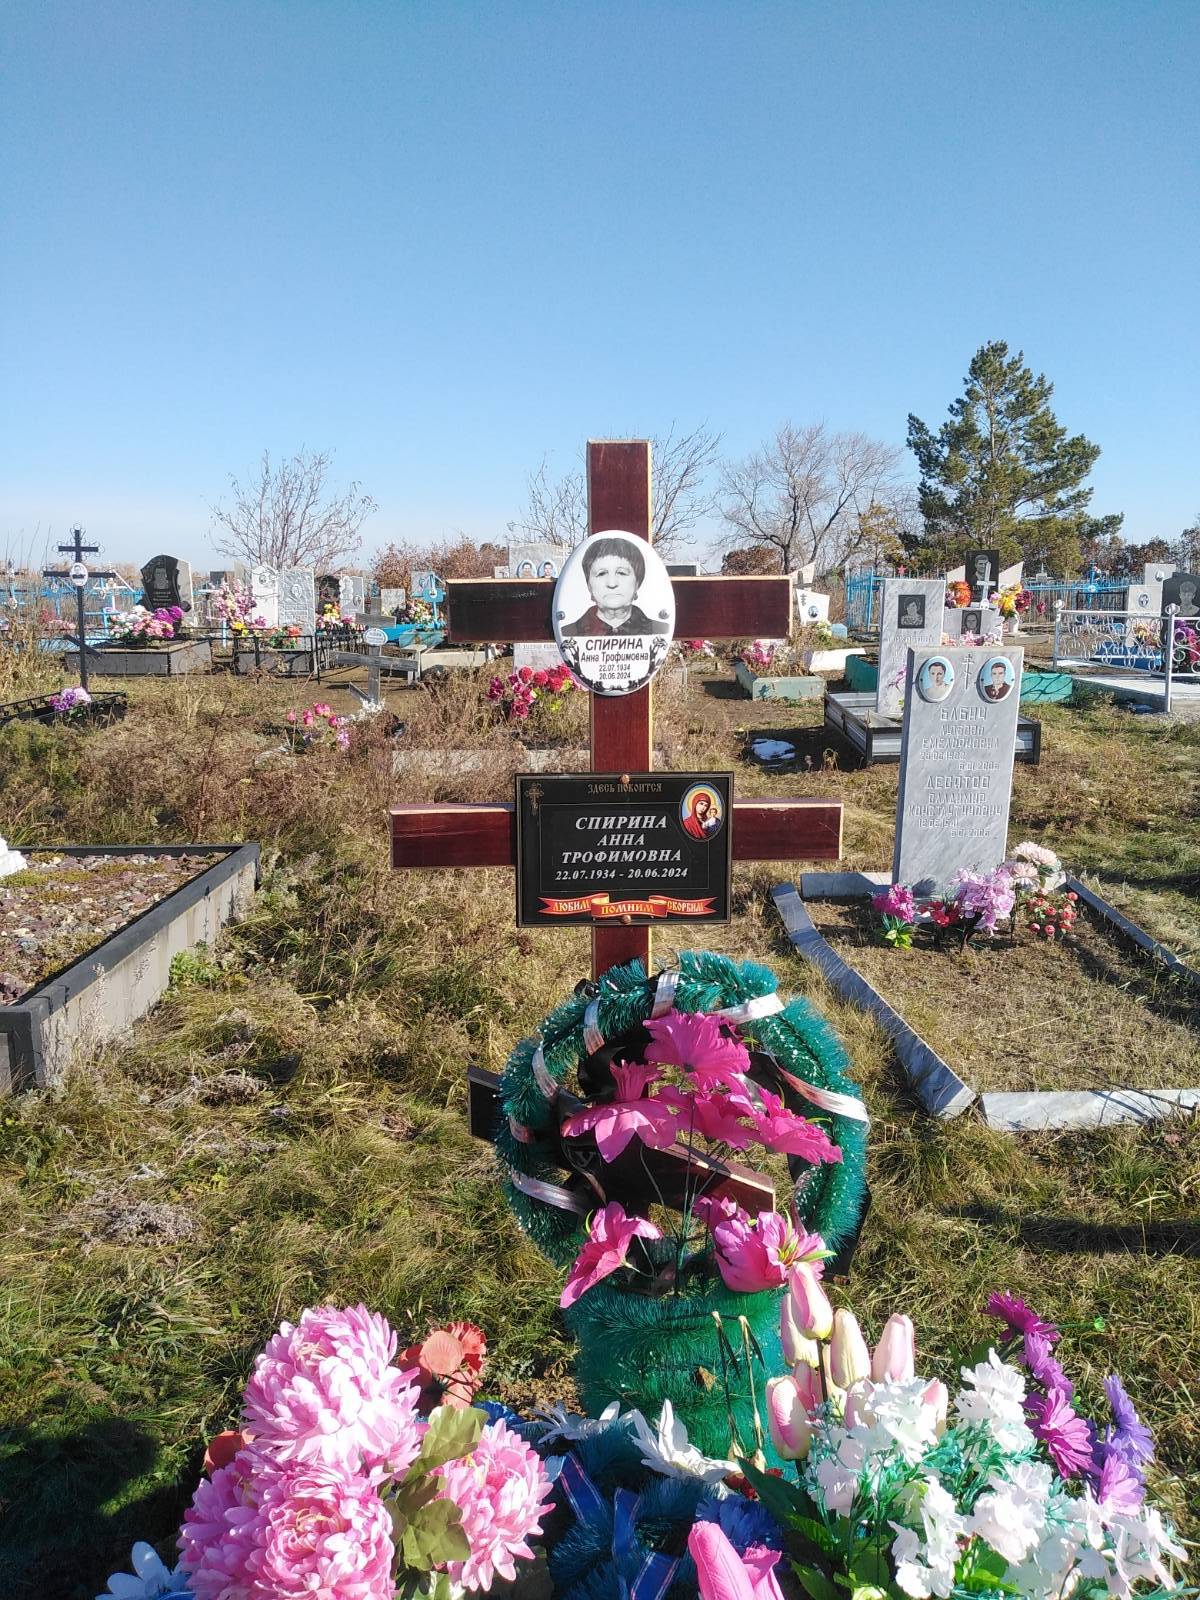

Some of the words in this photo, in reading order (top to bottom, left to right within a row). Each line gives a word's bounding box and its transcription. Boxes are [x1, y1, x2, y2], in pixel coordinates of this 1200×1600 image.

[586, 638, 643, 651] СПИРИНА
[581, 652, 599, 662] Анна
[602, 651, 649, 663] Трофимовна
[599, 664, 631, 672] 22.07.1934
[599, 672, 631, 680] 20.06.2024
[940, 707, 988, 721] БАБИЧ
[587, 784, 615, 794] ЗДЕСЬ
[617, 783, 663, 793] ПОКОИТСЯ
[928, 792, 986, 804] ВЛАДИМИР
[907, 804, 1003, 817] КОНСТАНТИНОВИЧ
[575, 816, 668, 830] СПИРИНА
[597, 834, 645, 846] АННА
[561, 849, 681, 864] ТРОФИМОВНА
[555, 869, 616, 881] 22.07.1934
[627, 867, 689, 879] 20.06.2024
[601, 903, 655, 915] ПОМНИМ
[667, 900, 704, 912] СКОРБИМ
